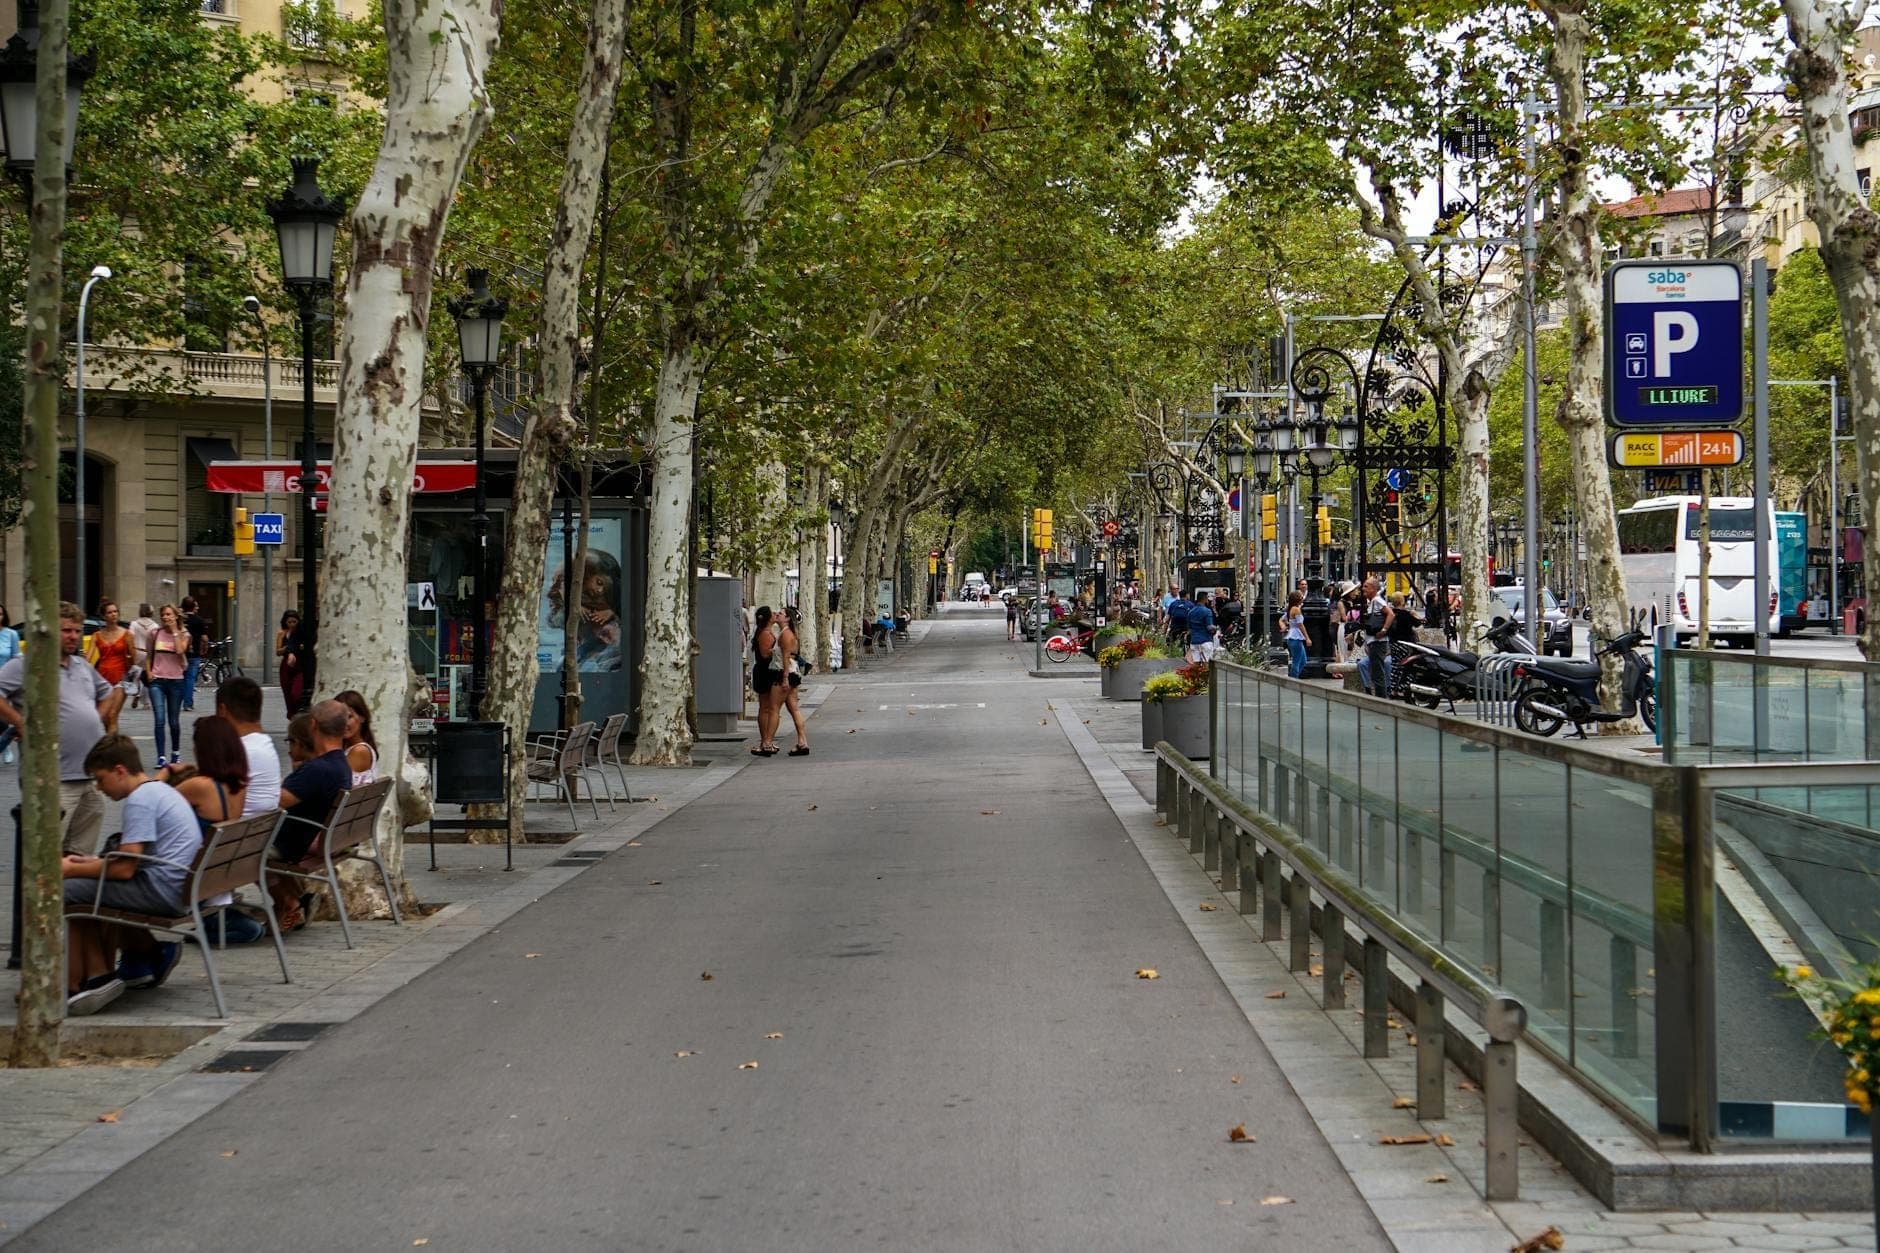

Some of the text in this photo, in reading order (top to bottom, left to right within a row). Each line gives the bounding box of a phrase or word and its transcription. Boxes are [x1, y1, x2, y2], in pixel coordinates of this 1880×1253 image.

[1648, 268, 1686, 283] saba
[1654, 310, 1700, 378] P
[1627, 443, 1656, 451] RACC
[254, 524, 282, 534] TAXI
